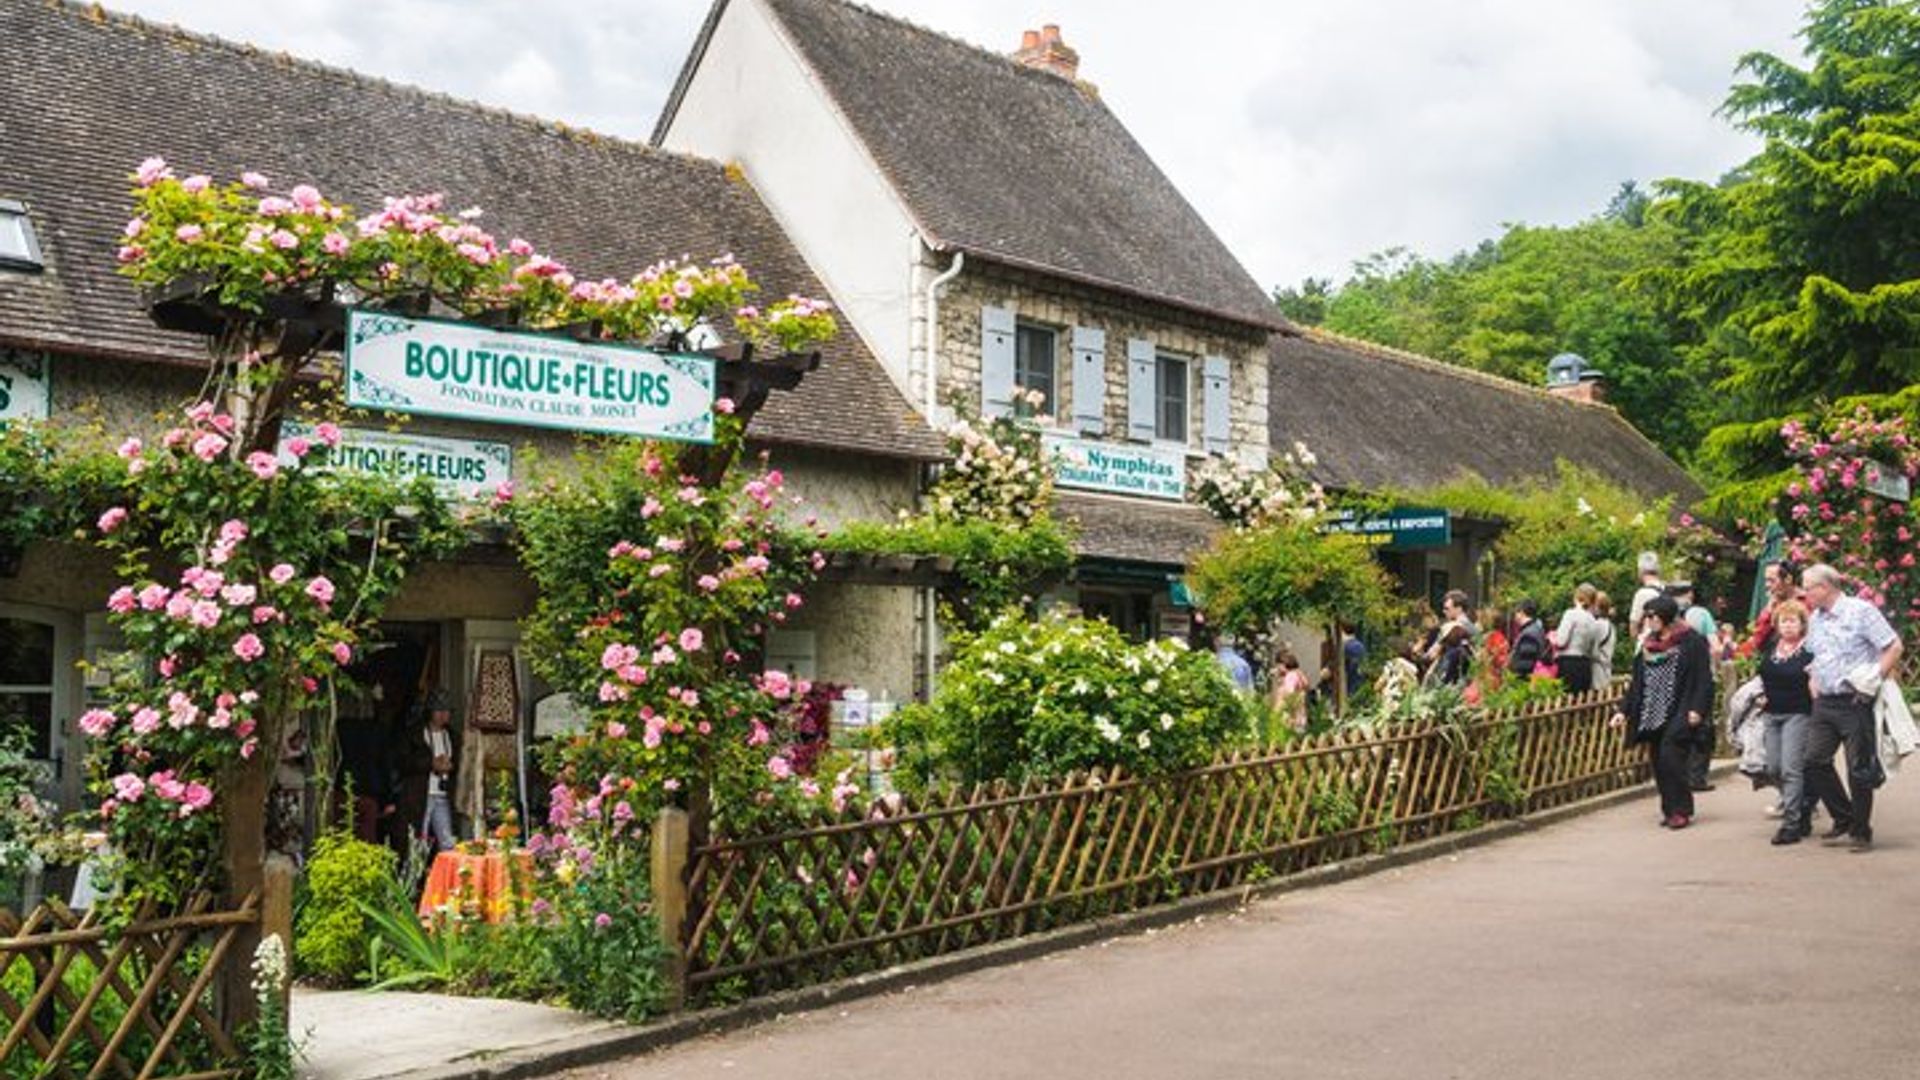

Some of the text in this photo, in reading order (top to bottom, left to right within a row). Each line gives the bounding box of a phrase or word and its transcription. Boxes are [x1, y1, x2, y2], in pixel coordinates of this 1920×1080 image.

[404, 341, 561, 395] BOUTIQUE
[574, 359, 671, 408] FLEURS
[440, 383, 638, 419] FONDATION CLAUDE MONET
[329, 444, 407, 476] UTIQUE
[416, 453, 487, 483] FLEURS
[1087, 450, 1174, 476] Nymphéas
